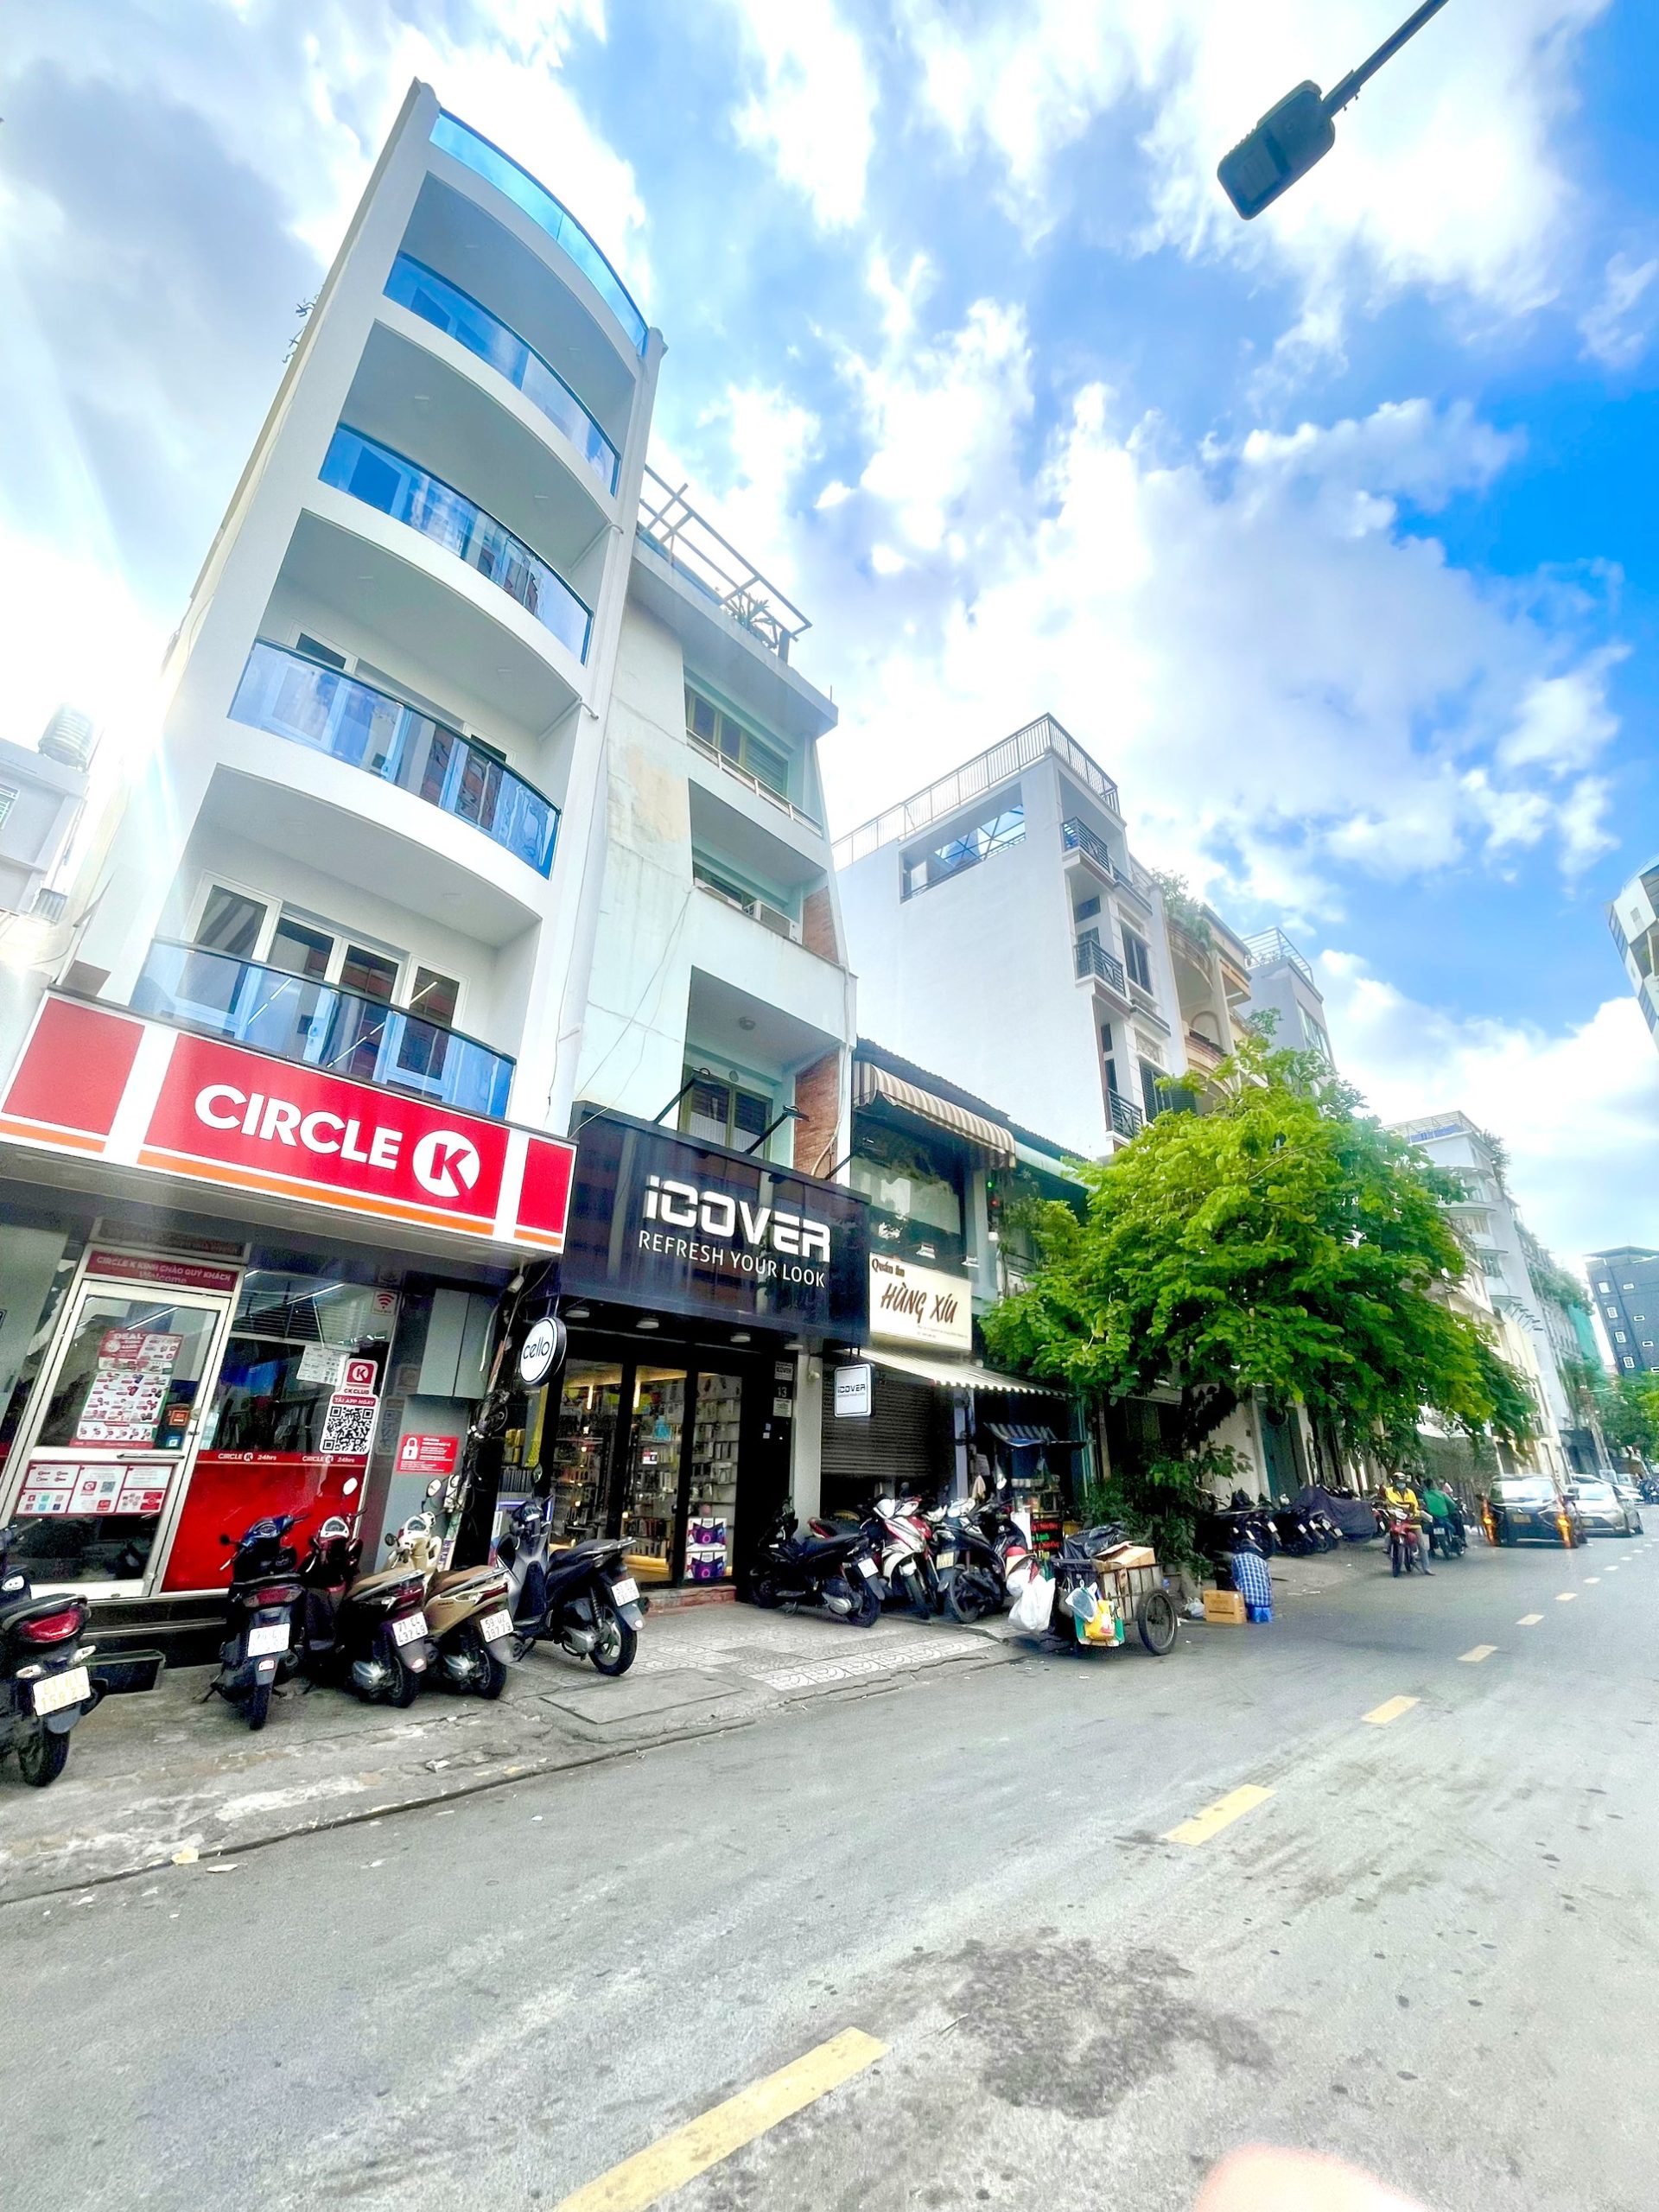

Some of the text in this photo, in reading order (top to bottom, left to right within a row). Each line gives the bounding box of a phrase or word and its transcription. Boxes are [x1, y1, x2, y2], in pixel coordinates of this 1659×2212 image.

[194, 1084, 479, 1198] CIRCLE K
[97, 1256, 128, 1268] CIRCLE
[639, 1230, 825, 1288] REFRESH YOUR LOOK
[880, 1281, 927, 1324] HÙNG
[523, 1337, 550, 1359] cello
